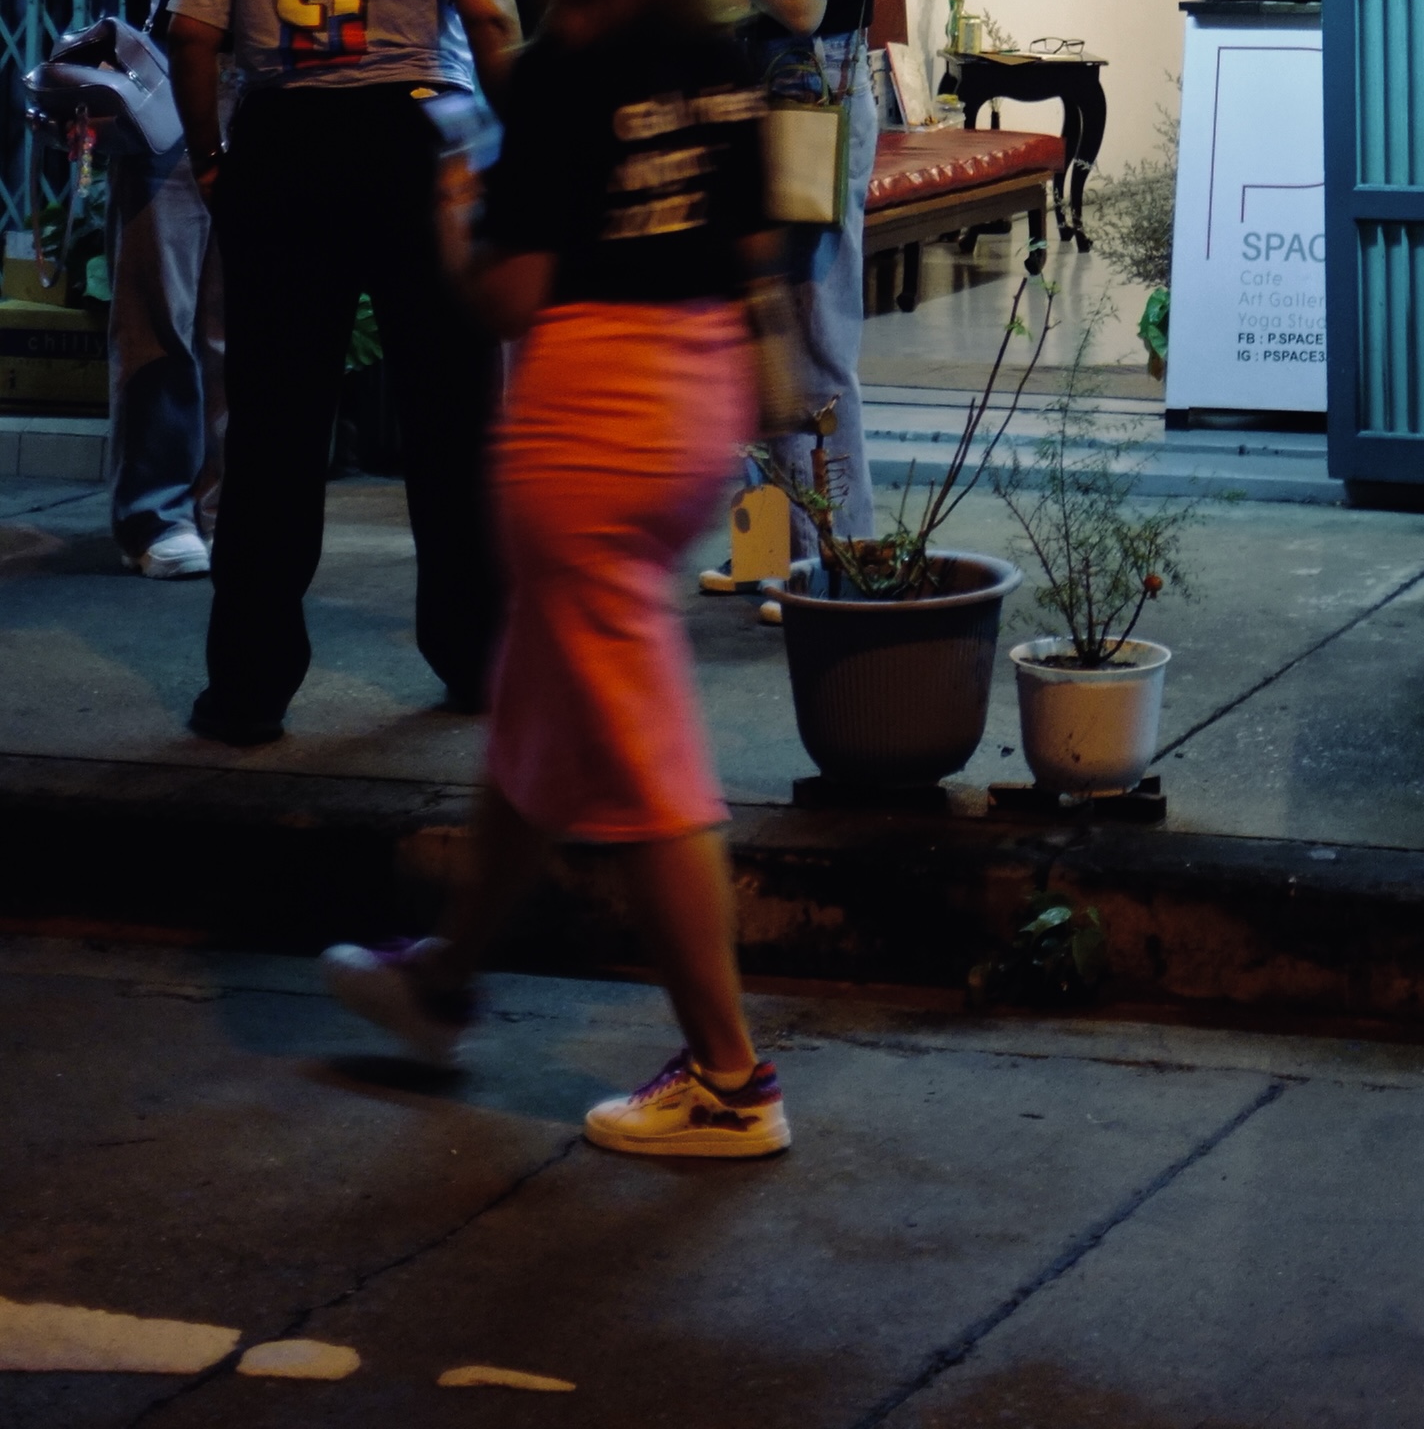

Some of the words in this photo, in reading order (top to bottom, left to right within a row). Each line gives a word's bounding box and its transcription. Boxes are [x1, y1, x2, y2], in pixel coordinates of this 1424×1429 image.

[1240, 270, 1282, 286] Cafe
[1239, 291, 1262, 305] Art
[1239, 312, 1281, 331] Yoga
[1238, 332, 1255, 344] FB
[1237, 349, 1251, 361] IG
